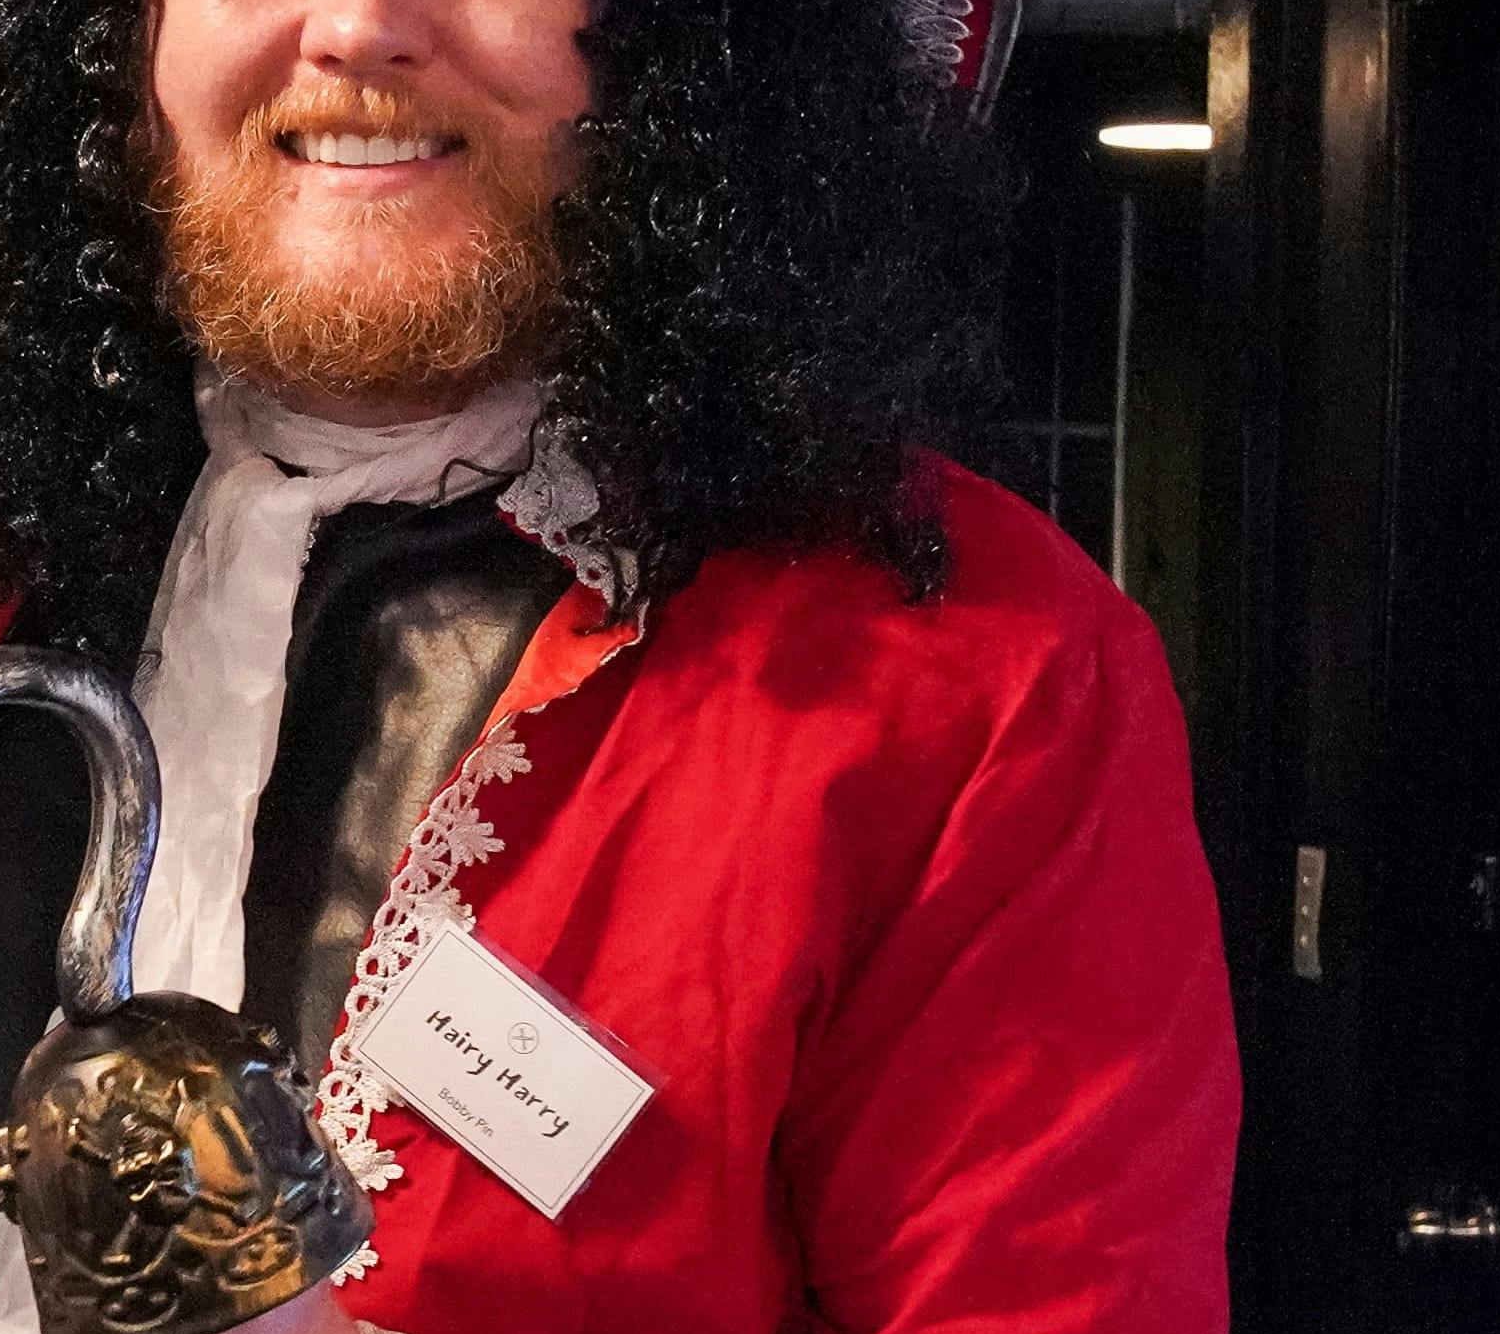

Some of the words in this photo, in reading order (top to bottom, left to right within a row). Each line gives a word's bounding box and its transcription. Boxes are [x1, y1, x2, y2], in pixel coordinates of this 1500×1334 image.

[425, 1009, 494, 1076] Hairy
[496, 1068, 571, 1138] Harry
[438, 1087, 475, 1123] Bobby
[475, 1116, 495, 1138] Pin
